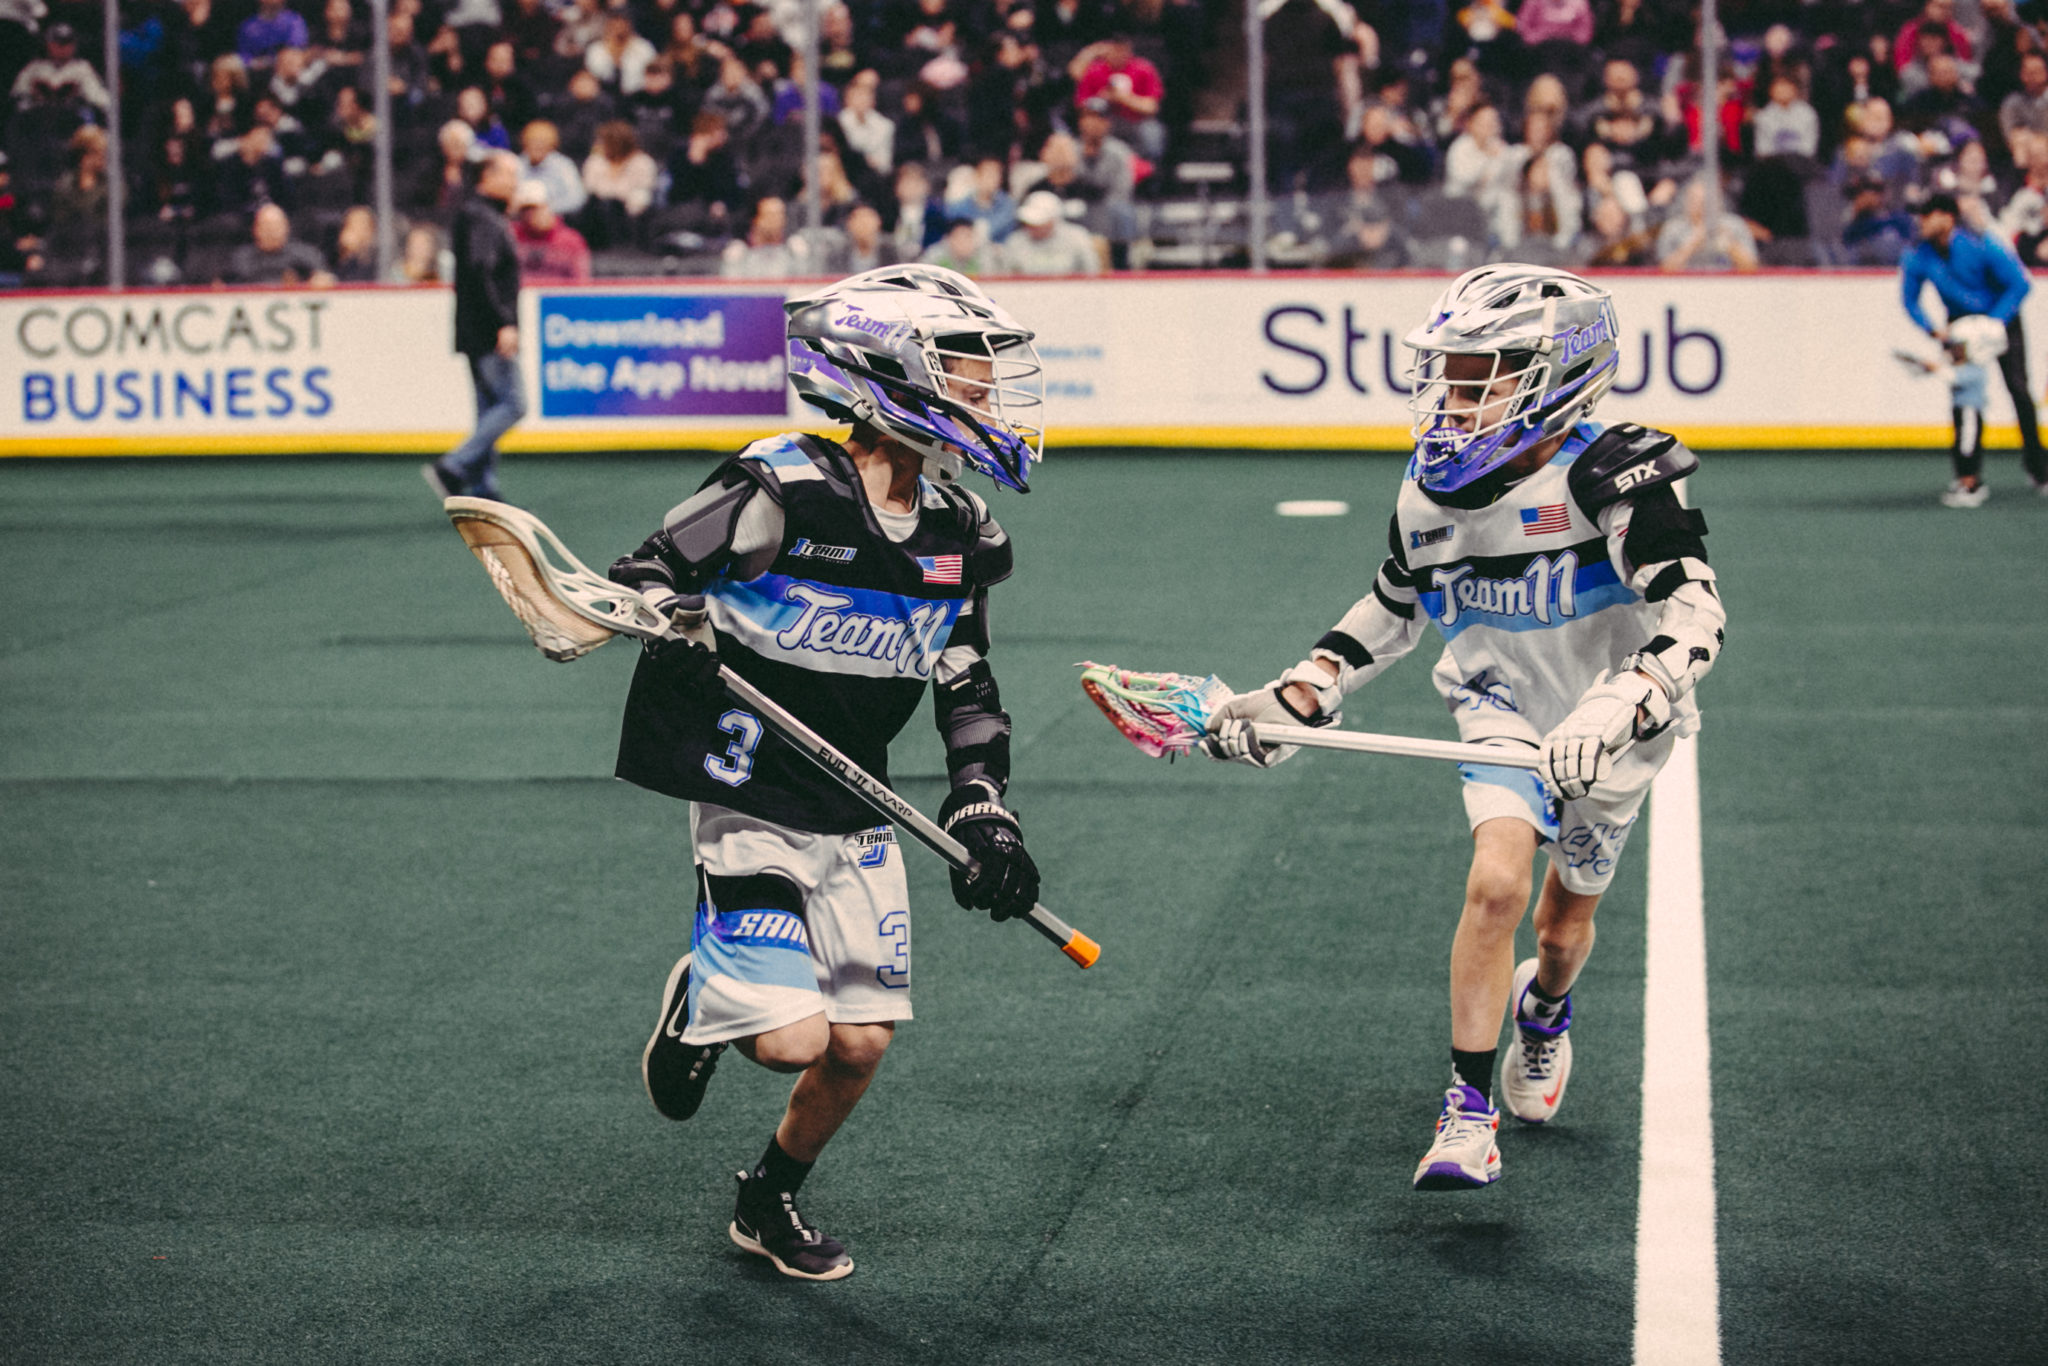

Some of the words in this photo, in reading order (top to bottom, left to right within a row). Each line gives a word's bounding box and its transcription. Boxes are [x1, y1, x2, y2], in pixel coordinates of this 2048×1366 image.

[17, 302, 327, 358] COMCAST
[544, 311, 725, 349] Download
[1261, 305, 1725, 395] Stuub
[22, 367, 333, 421] BUSINESS
[544, 357, 608, 393] the
[610, 355, 686, 400] App
[1614, 460, 1661, 494] STX
[1432, 550, 1579, 627] Team11
[777, 583, 950, 677] Team11
[704, 708, 764, 787] 3
[876, 911, 910, 989] 3
